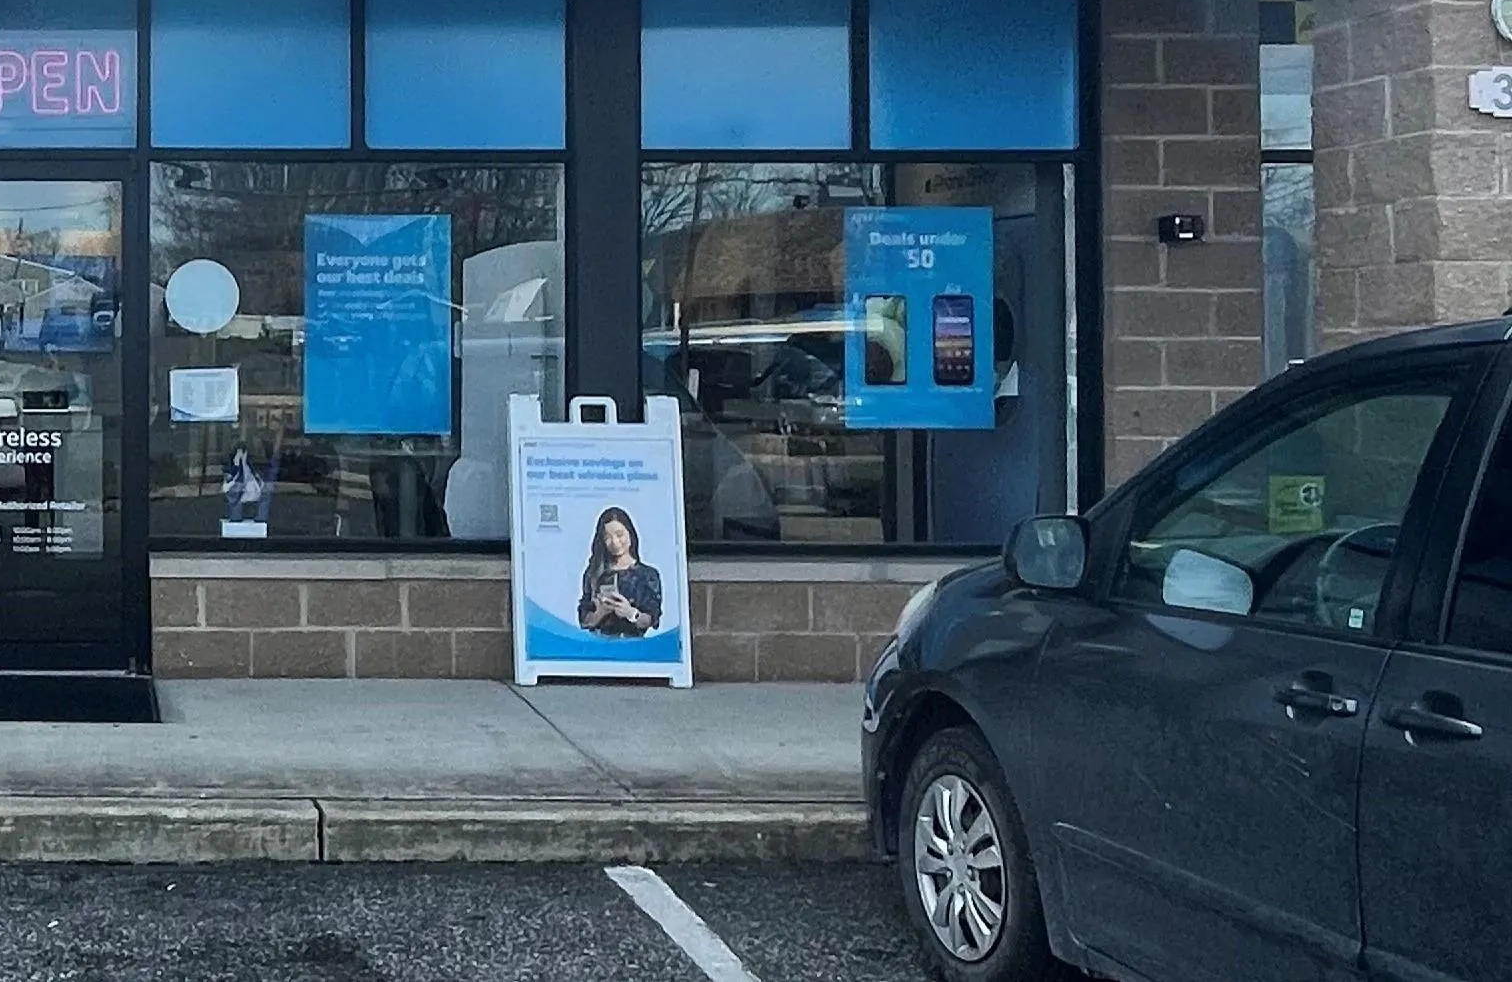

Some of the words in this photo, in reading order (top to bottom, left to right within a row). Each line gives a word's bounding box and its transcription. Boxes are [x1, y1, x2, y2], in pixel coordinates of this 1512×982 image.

[869, 232, 916, 246] Deals
[919, 232, 968, 246] under
[316, 252, 388, 271] Everyone
[392, 254, 427, 271] gets
[316, 272, 344, 284] our
[346, 270, 381, 284] best
[383, 270, 425, 284] deals
[526, 457, 580, 467] Exclusive
[582, 458, 626, 469] savings
[628, 460, 644, 468] on
[526, 471, 546, 479] our
[549, 470, 574, 480] best
[577, 470, 625, 480] wireless
[626, 471, 659, 482] plans
